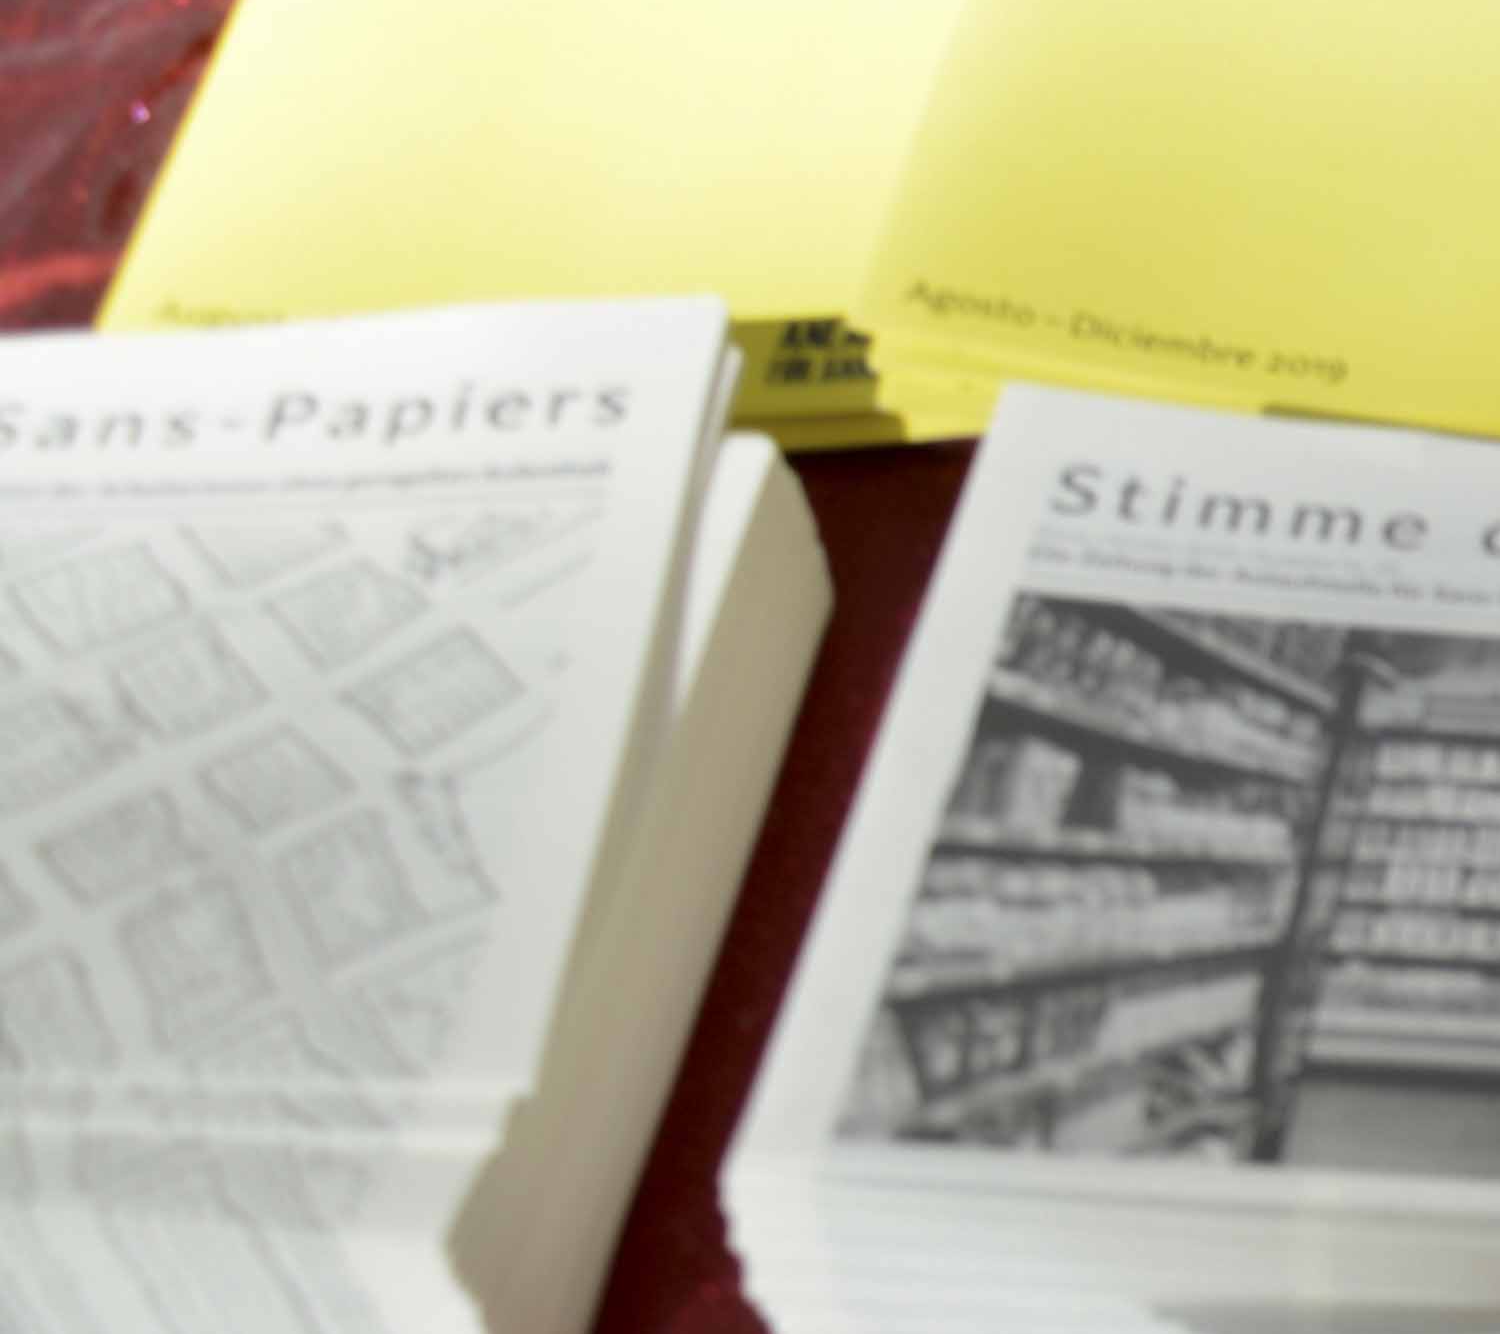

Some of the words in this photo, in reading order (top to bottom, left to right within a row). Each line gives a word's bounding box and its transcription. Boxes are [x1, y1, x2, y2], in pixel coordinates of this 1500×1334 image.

[905, 279, 1038, 329] Agosto
[1069, 308, 1257, 370] Diciembre
[1264, 351, 1348, 385] 2019
[1047, 463, 1431, 553] Stimme
